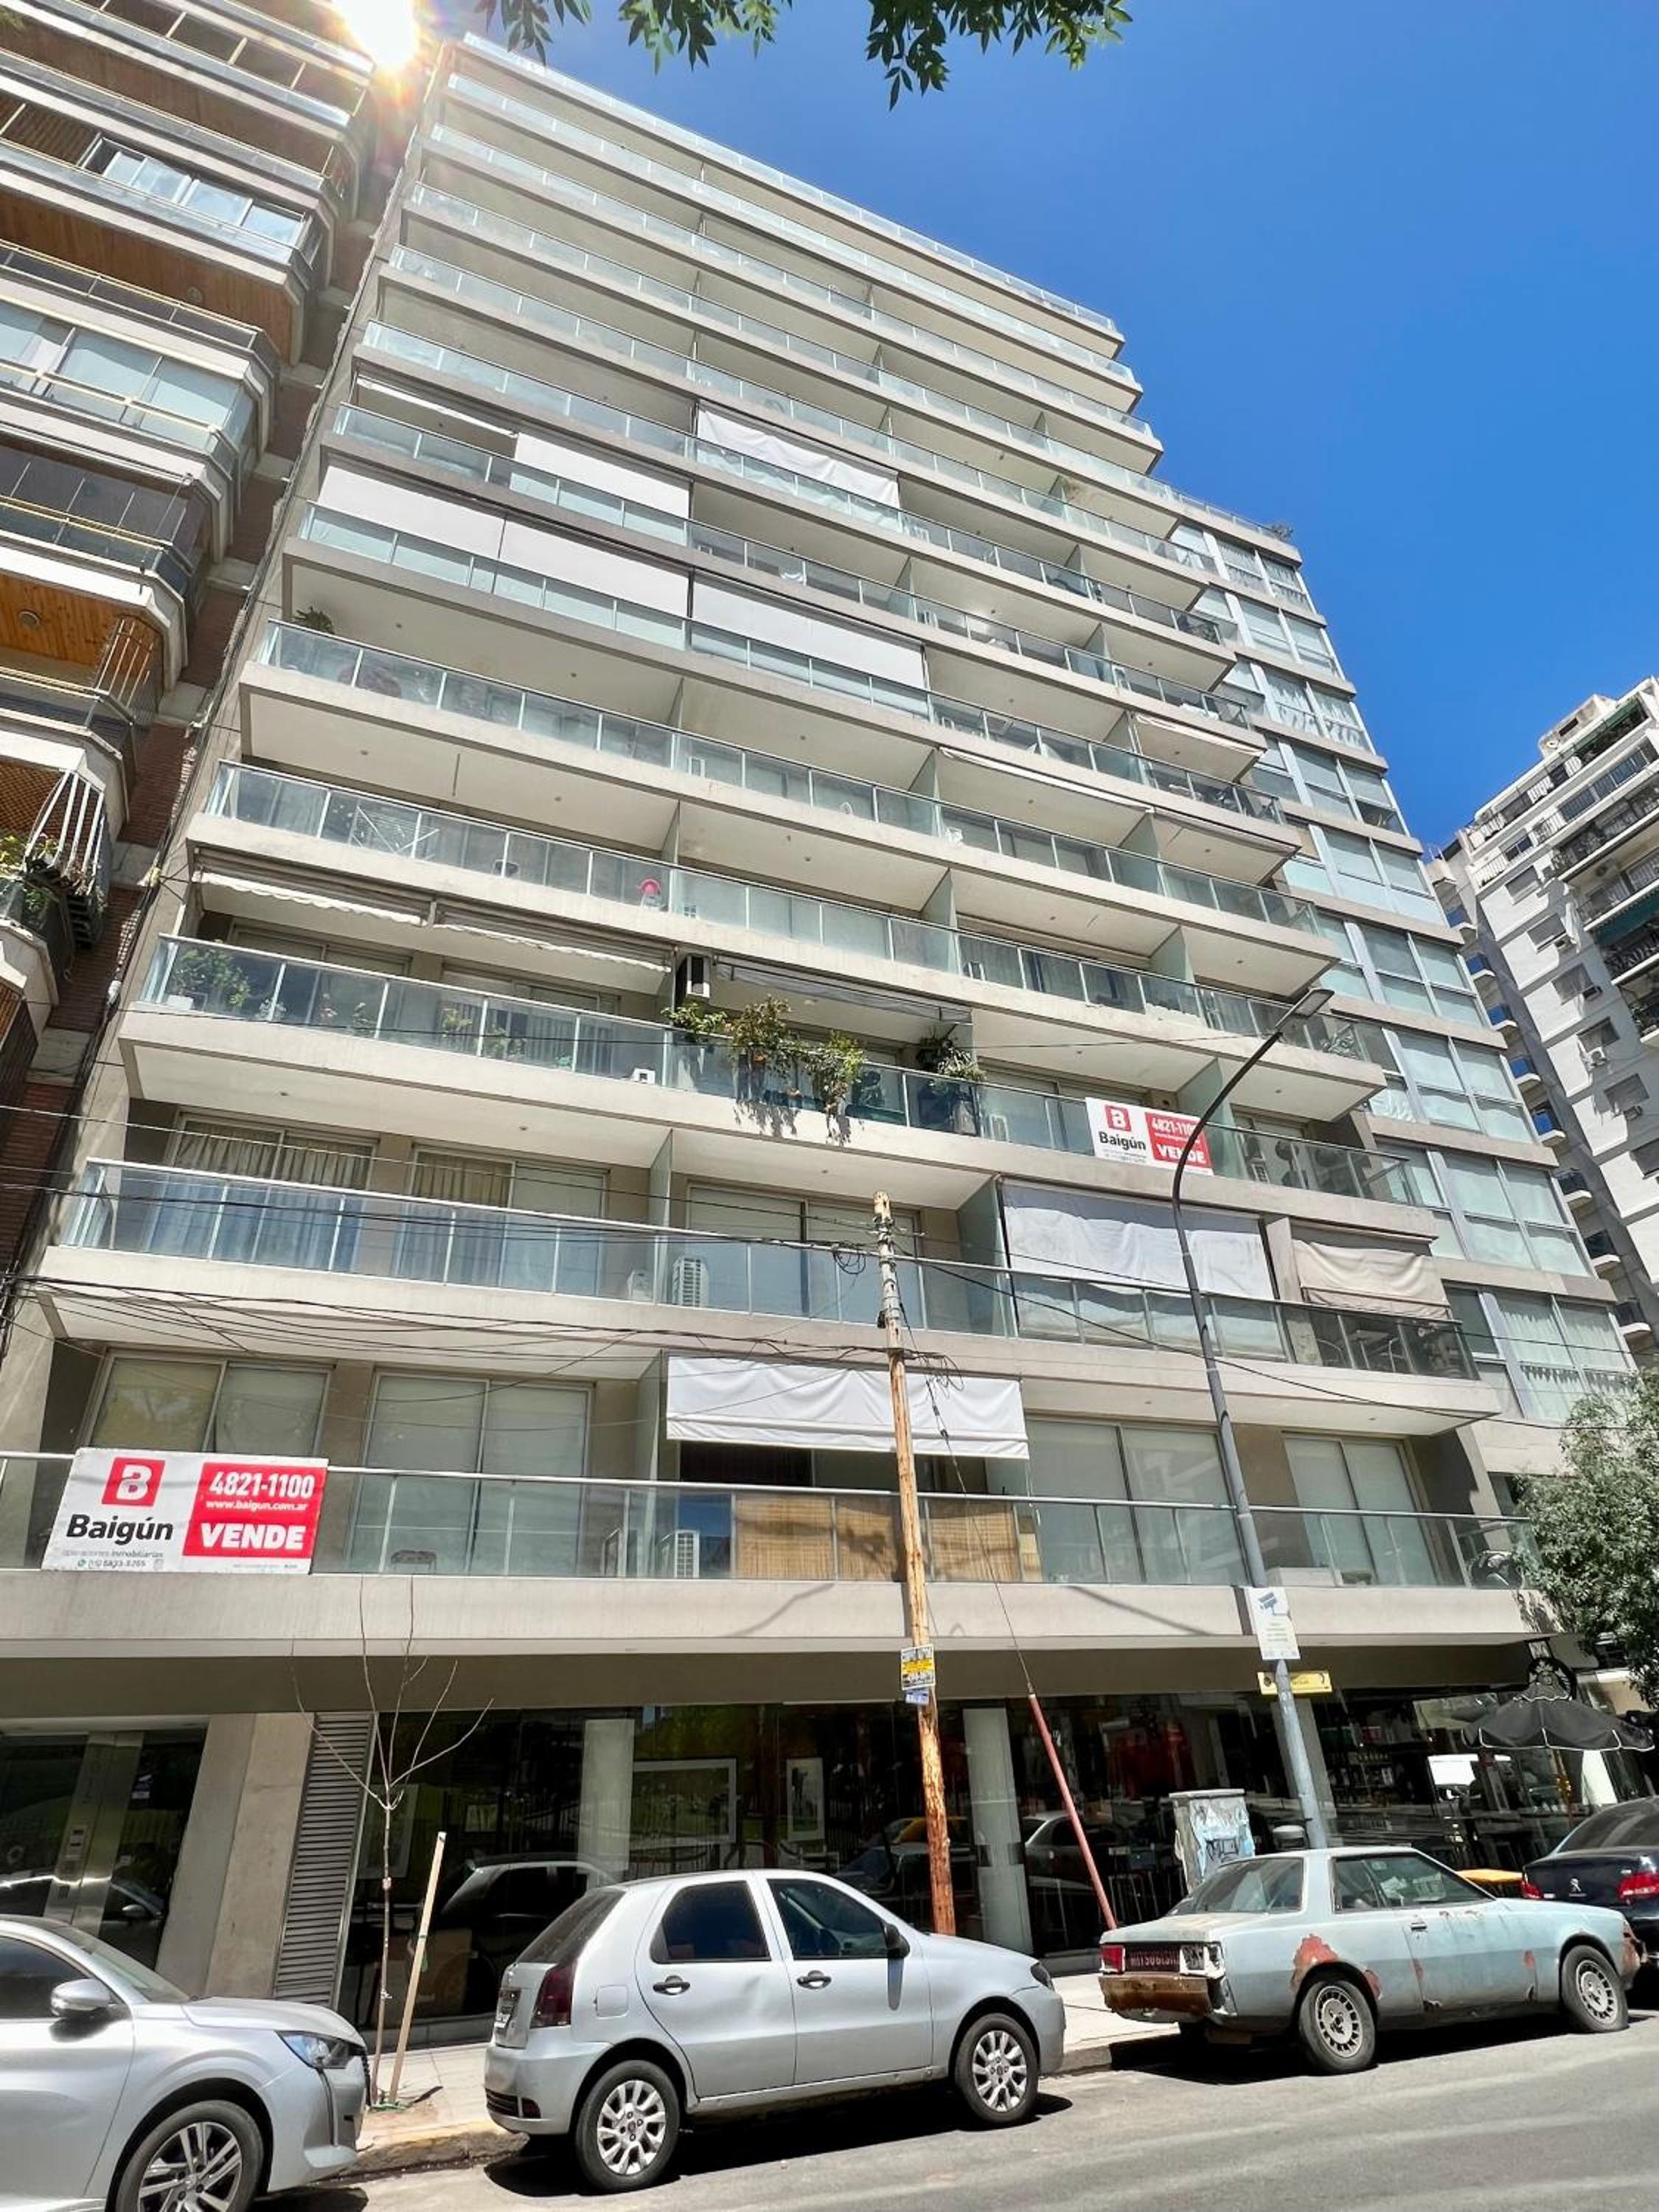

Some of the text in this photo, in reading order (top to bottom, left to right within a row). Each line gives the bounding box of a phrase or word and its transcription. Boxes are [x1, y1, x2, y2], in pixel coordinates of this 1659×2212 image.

[1152, 1117, 1195, 1136] 4821-110
[1099, 1131, 1147, 1151] Baigún
[209, 1470, 315, 1499] 4821-1100
[206, 1500, 307, 1512] www.baigun.com.ar
[66, 1513, 174, 1545] Baigún
[201, 1522, 307, 1550] VENDE
